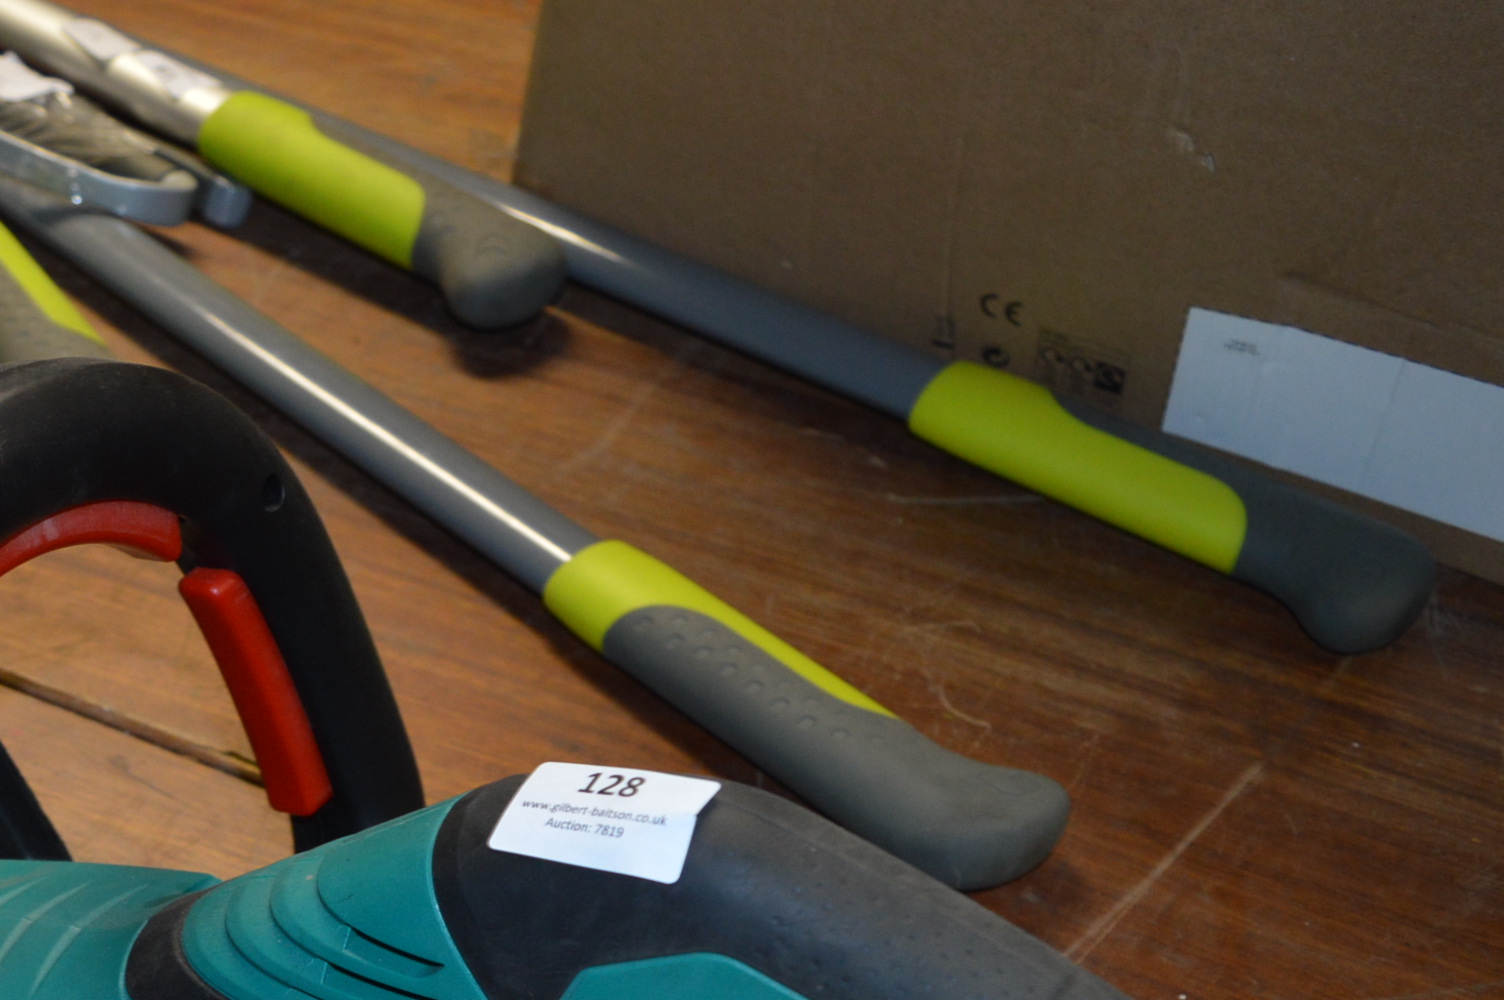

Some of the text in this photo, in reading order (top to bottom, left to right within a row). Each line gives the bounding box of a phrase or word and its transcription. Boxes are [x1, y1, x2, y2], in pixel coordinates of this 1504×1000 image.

[578, 772, 647, 797] 128
[522, 799, 668, 827] www.gilbert-baitson.co.uk
[545, 817, 625, 838] Auction: 7819
